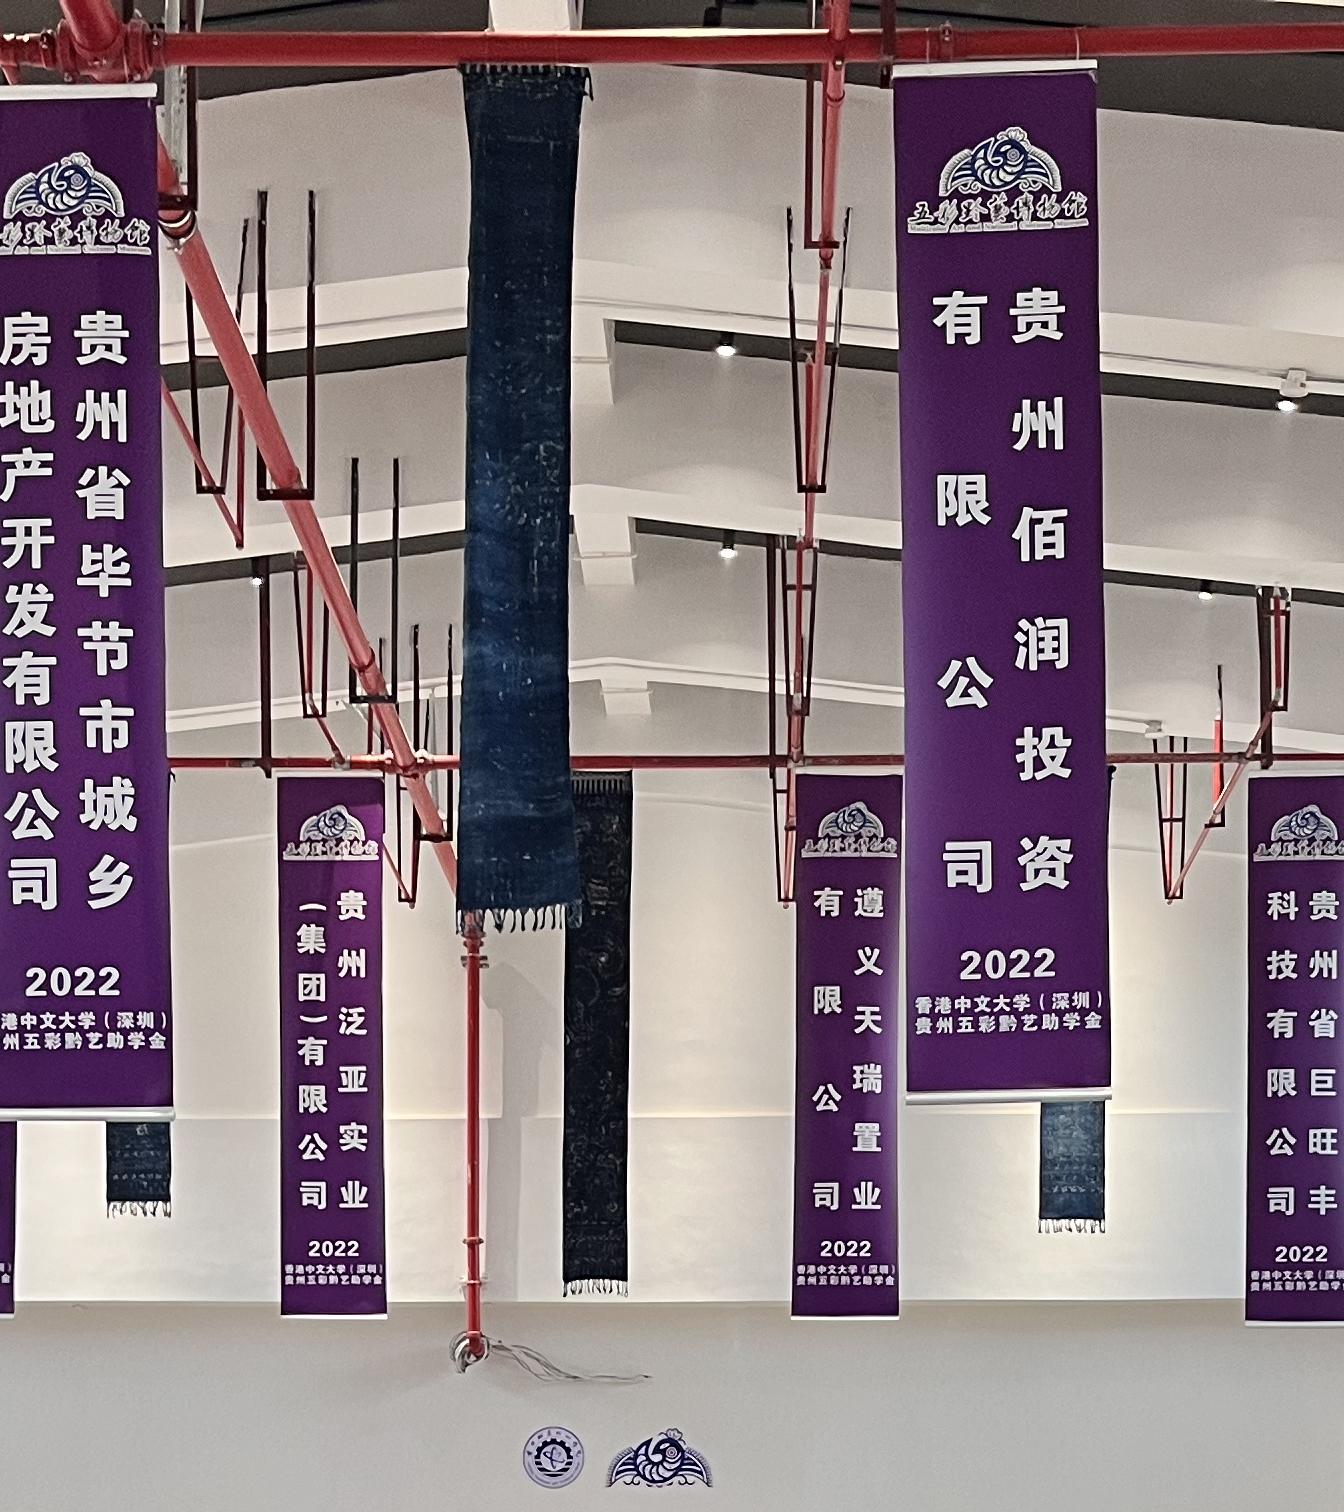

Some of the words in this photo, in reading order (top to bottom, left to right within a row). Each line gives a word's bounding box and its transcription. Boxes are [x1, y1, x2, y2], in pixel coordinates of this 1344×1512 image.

[74, 310, 138, 911] 贵州省毕节市城乡
[932, 290, 994, 893] 有限公司
[1010, 287, 1074, 892] 贵州佰润投资
[25, 966, 120, 997] 2022
[336, 889, 369, 1209] 贵州泛亚实业
[812, 887, 844, 1211] 有限公司
[851, 887, 884, 1210] 遵义天瑞置业
[960, 948, 1056, 980] 2022
[1266, 890, 1298, 1216] 科技有限公司
[1307, 890, 1340, 1216] 贵州省巨旺丰
[308, 1240, 359, 1257] 2022
[820, 1240, 871, 1257] 2022
[1275, 1245, 1328, 1263] 2022
